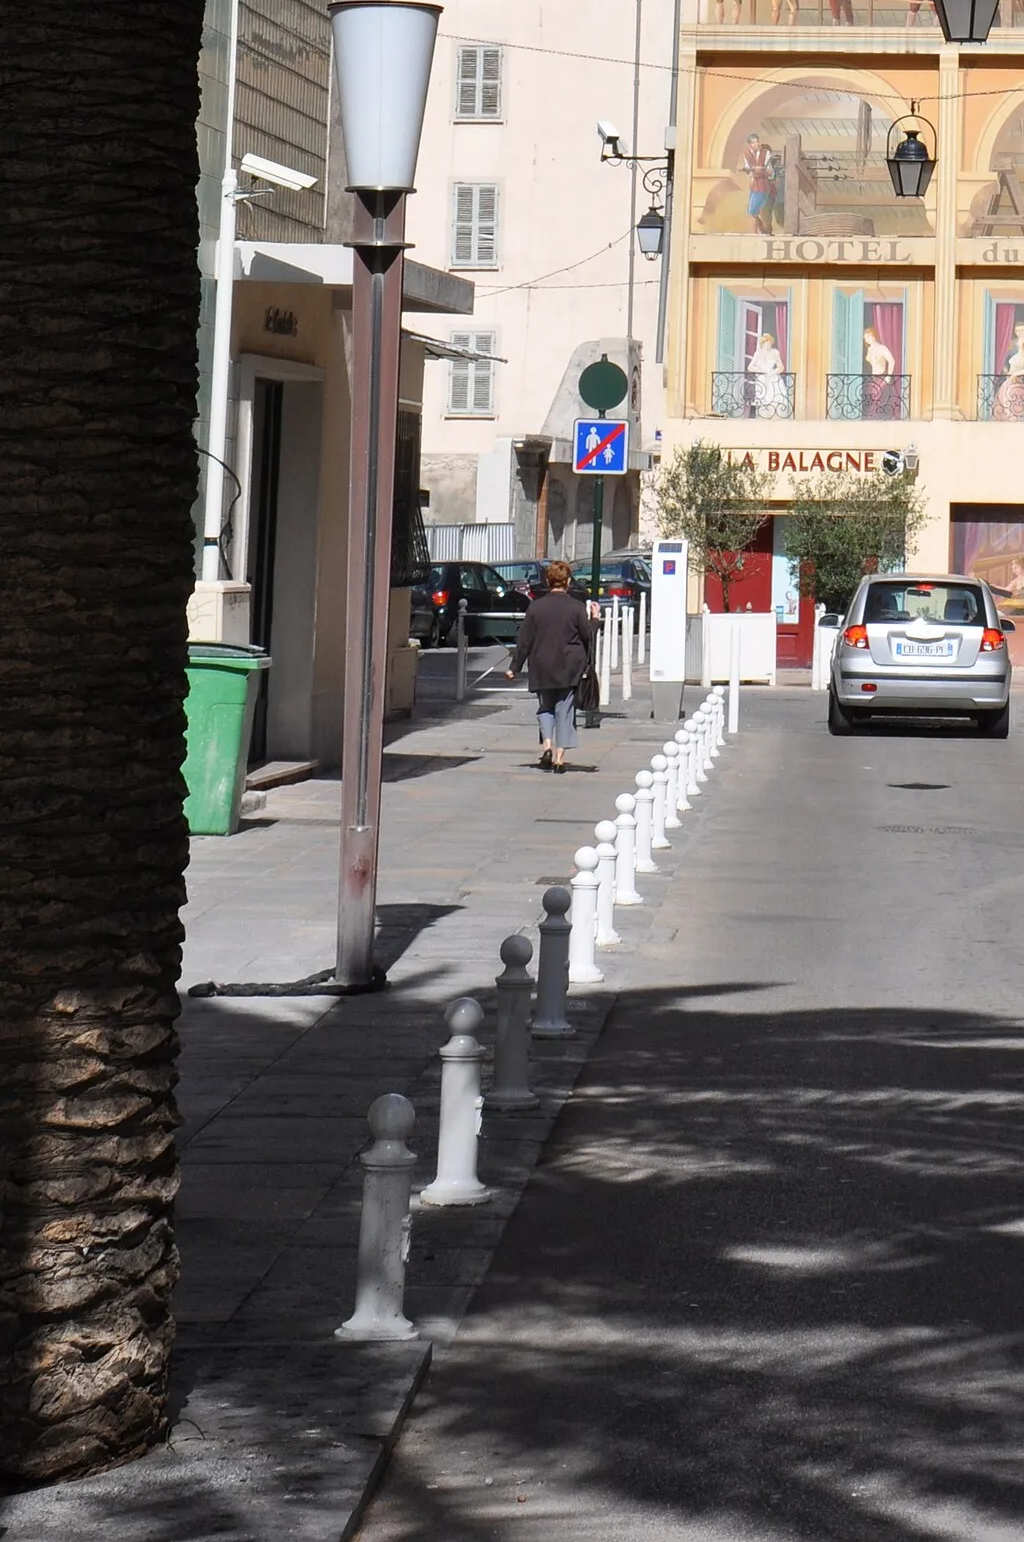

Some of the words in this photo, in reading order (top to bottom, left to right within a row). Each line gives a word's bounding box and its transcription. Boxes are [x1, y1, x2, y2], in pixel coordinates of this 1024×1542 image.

[763, 239, 912, 263] HOTEL
[982, 242, 1020, 264] du
[727, 450, 755, 472] LA
[767, 451, 877, 472] BALAGNE
